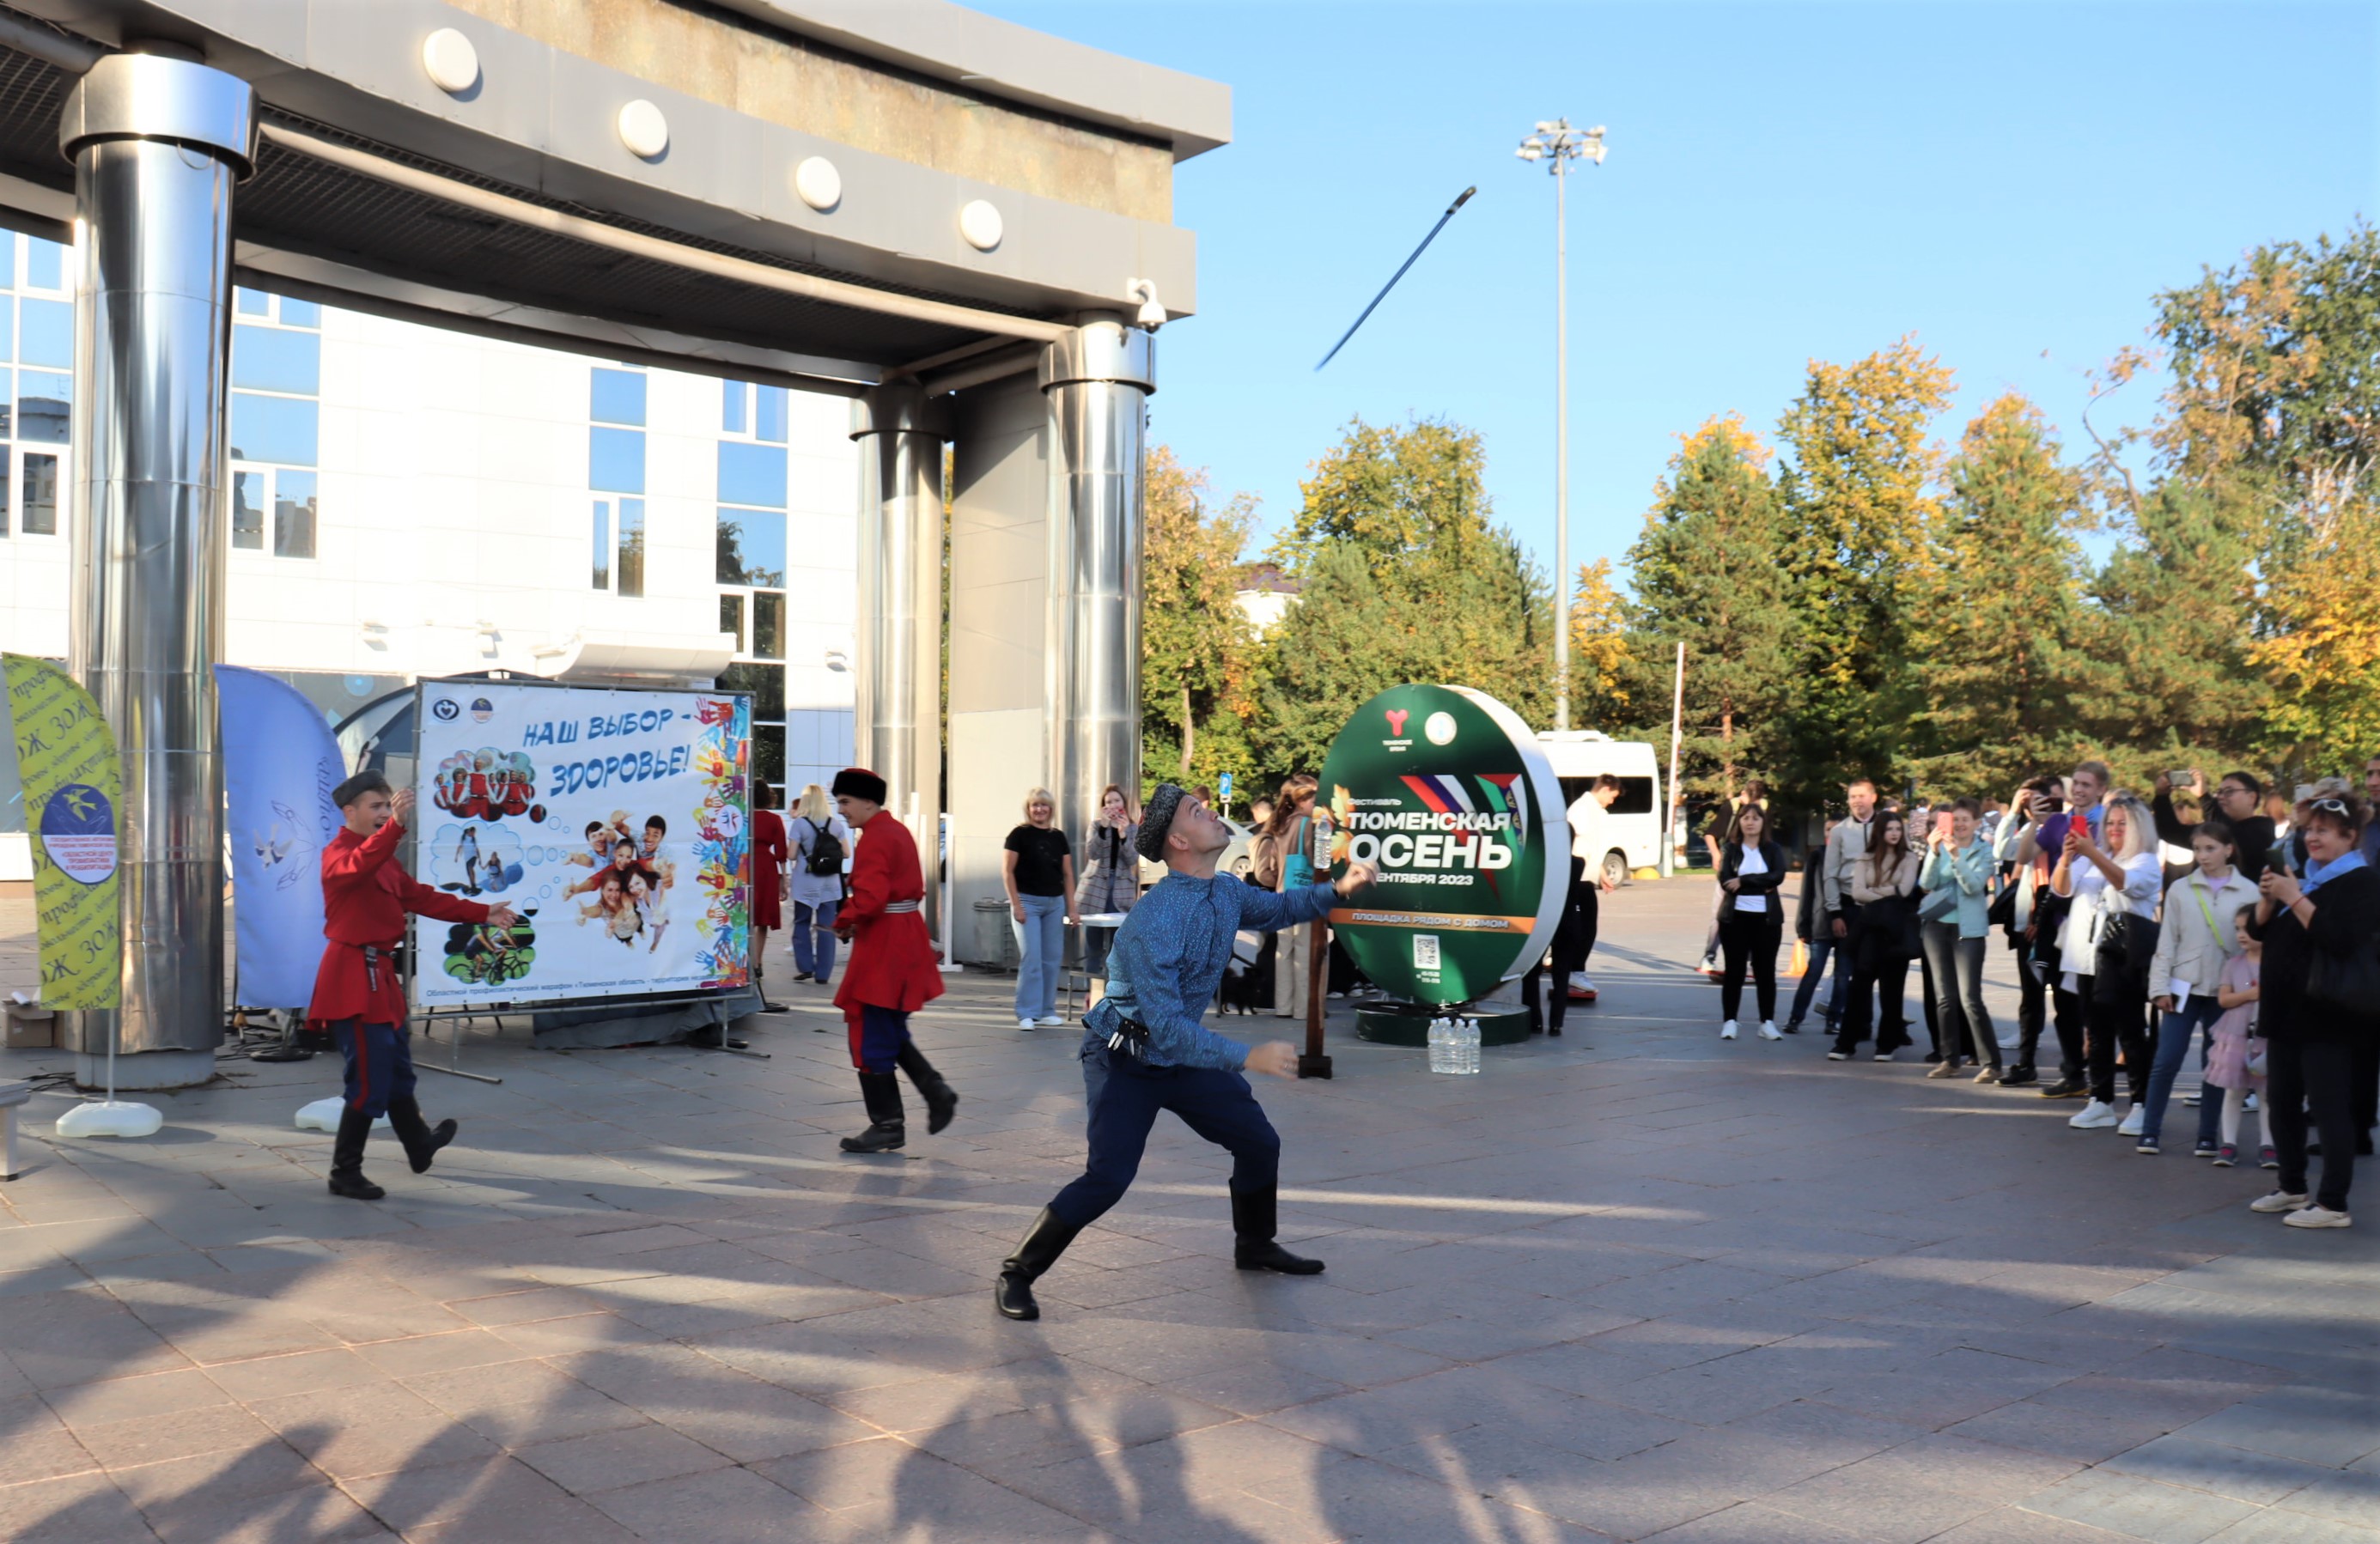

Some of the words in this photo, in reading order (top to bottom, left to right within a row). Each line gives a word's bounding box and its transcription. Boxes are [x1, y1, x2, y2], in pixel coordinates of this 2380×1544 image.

[49, 699, 95, 740] ЗОЖ
[522, 720, 579, 747] НАШ
[587, 708, 673, 739] ВЫБОР
[550, 745, 691, 797] ЗДОРОВЬЕ!
[1347, 812, 1512, 830] ТЮМЕНСКАЯ
[1348, 834, 1513, 870] ОСЕНЬ
[1376, 872, 1436, 884] ЕНТЯБРЯ
[1438, 873, 1474, 885] 2023
[1352, 912, 1410, 923] ПЛОЩАДКА
[1413, 915, 1451, 926] РЯДОМ
[1464, 919, 1509, 928] ДОМОМ
